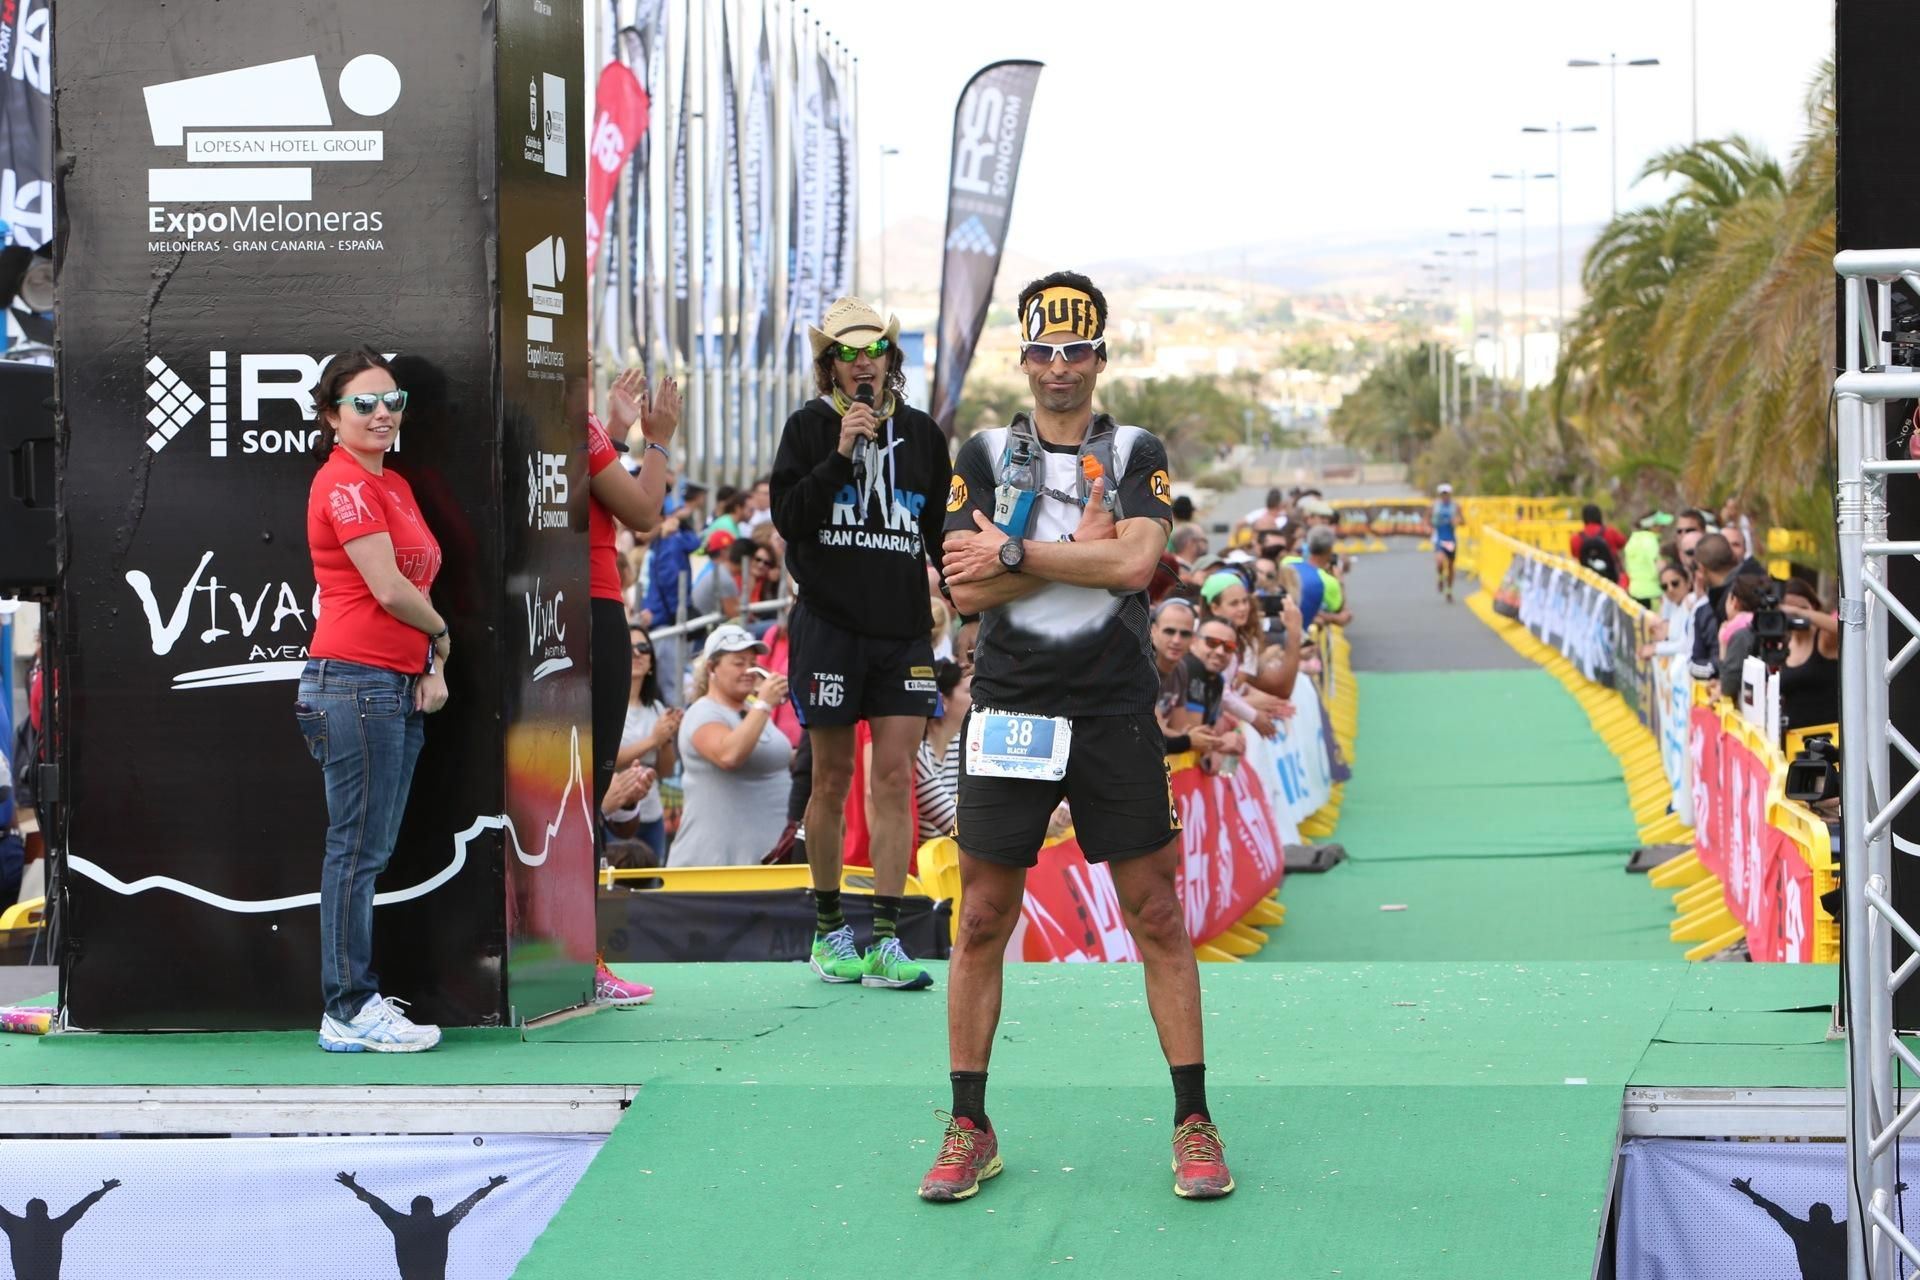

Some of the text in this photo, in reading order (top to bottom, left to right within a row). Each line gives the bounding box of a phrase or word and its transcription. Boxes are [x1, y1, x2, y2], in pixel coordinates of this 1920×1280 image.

[195, 139, 376, 153] LOPESAN HOTEL GROUP
[953, 86, 1004, 195] RS
[992, 95, 1021, 196] SONOCOM
[148, 204, 383, 239] ExpoMeloneras
[148, 241, 221, 252] MELONERAS
[233, 240, 267, 251] GRAN
[271, 240, 325, 251] CANARIA
[338, 238, 384, 251] ESPAÑA
[527, 344, 565, 368] ExpoMeloneras
[241, 353, 398, 421] R
[542, 454, 568, 504] RS
[543, 511, 568, 528] SONOCOM
[819, 529, 911, 553] GRAN CANARIA
[813, 672, 844, 682] TEAM
[1005, 719, 1034, 748] 38
